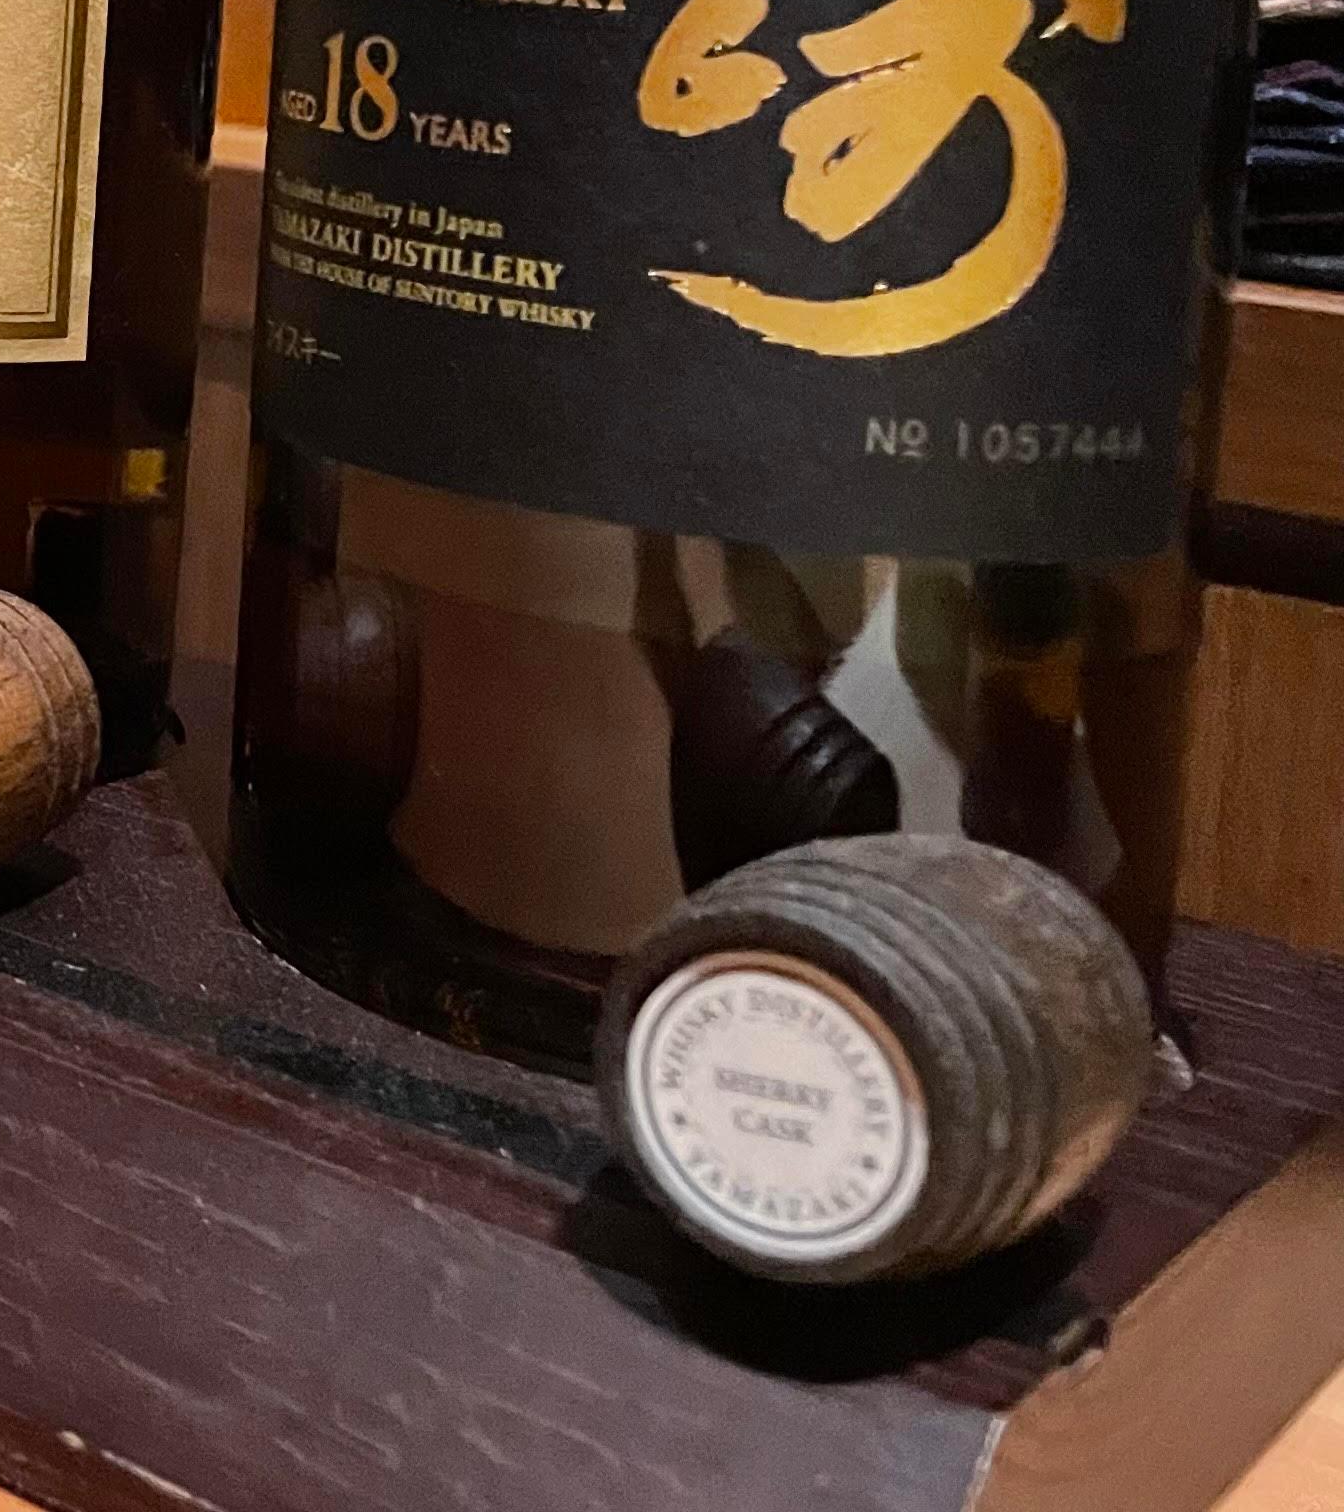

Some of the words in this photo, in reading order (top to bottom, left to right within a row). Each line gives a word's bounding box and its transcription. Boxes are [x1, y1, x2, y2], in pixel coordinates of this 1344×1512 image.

[319, 31, 400, 142] 18
[409, 111, 513, 156] YEARS
[434, 205, 506, 240] Japan
[371, 231, 565, 292] DISTILLERY
[497, 296, 597, 331] WHISKY
